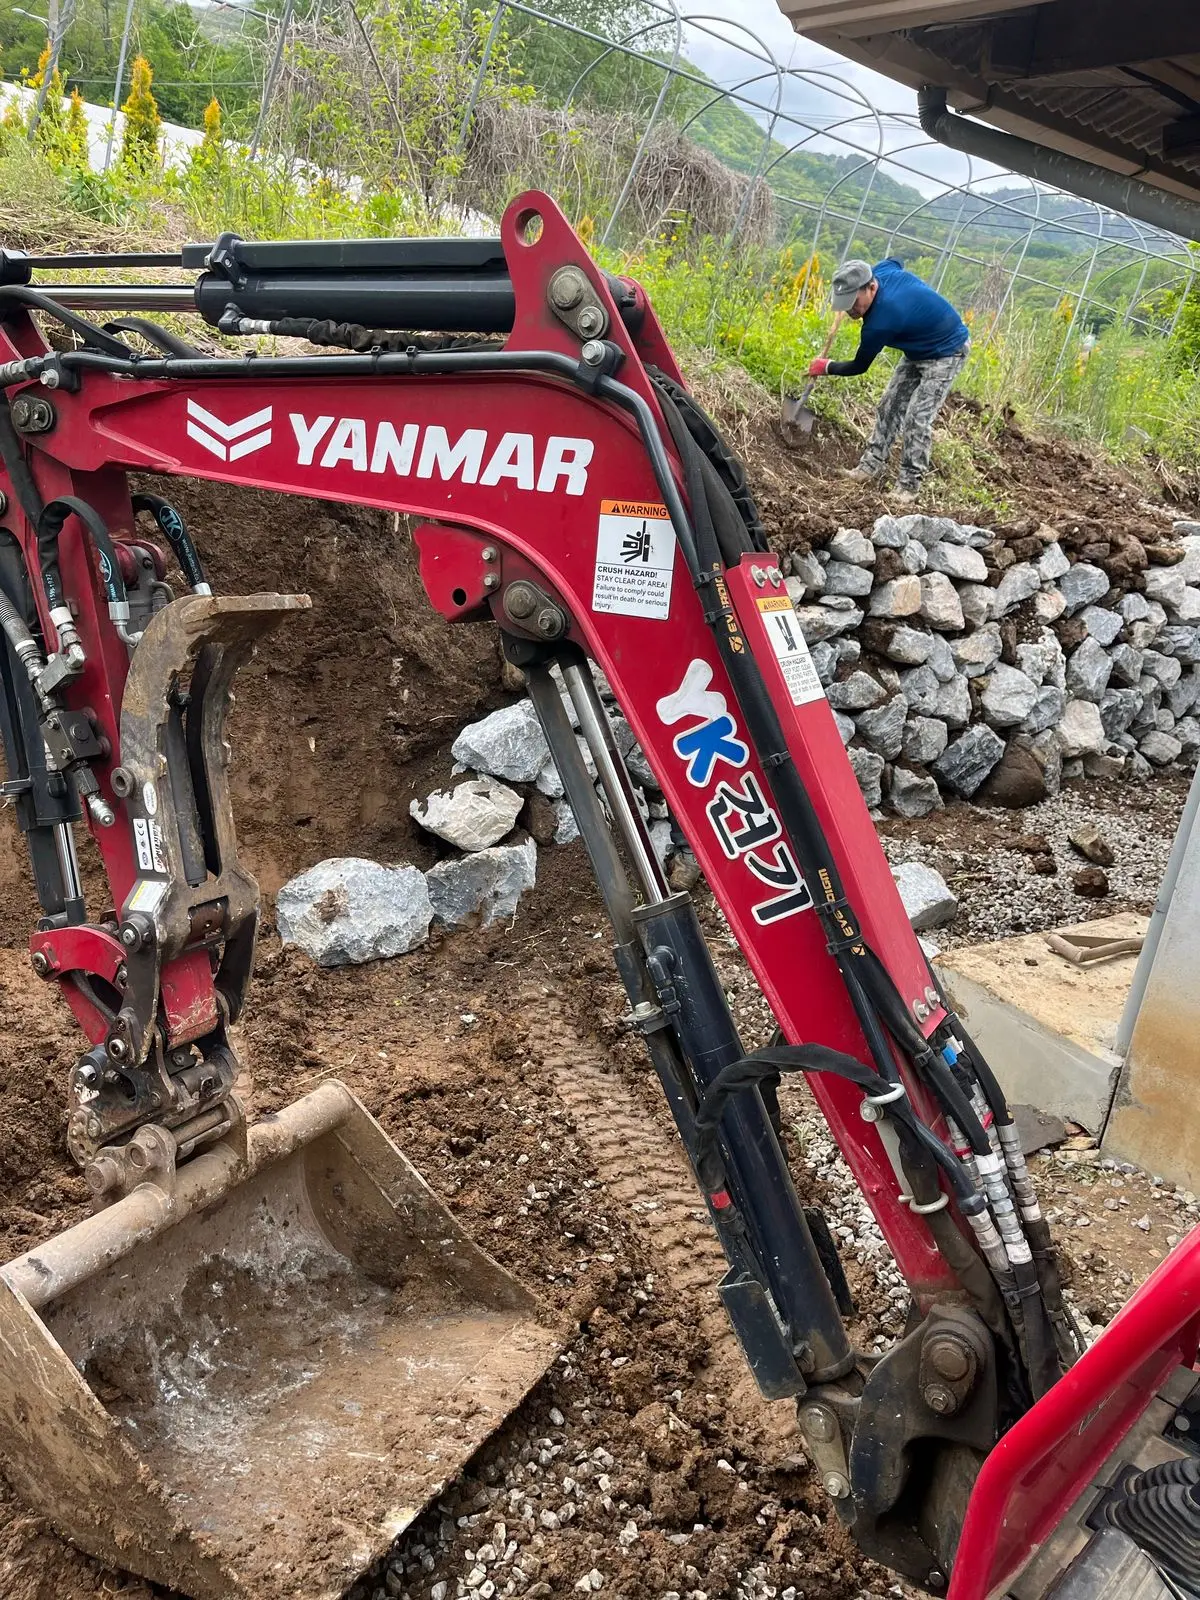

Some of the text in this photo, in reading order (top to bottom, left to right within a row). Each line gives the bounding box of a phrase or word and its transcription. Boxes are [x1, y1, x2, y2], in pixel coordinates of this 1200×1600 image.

[289, 413, 594, 496] YANMAR
[621, 504, 667, 516] WARNING
[161, 510, 181, 535] JK
[597, 565, 658, 579] CRUSH HAZARD!
[614, 576, 636, 585] CLEAR
[647, 580, 668, 589] AREA!
[595, 583, 616, 592] Failure
[624, 588, 646, 597] comply
[646, 590, 665, 598] could
[619, 595, 637, 603] death
[645, 599, 668, 607] serious
[818, 868, 854, 937] EVEDIGM
